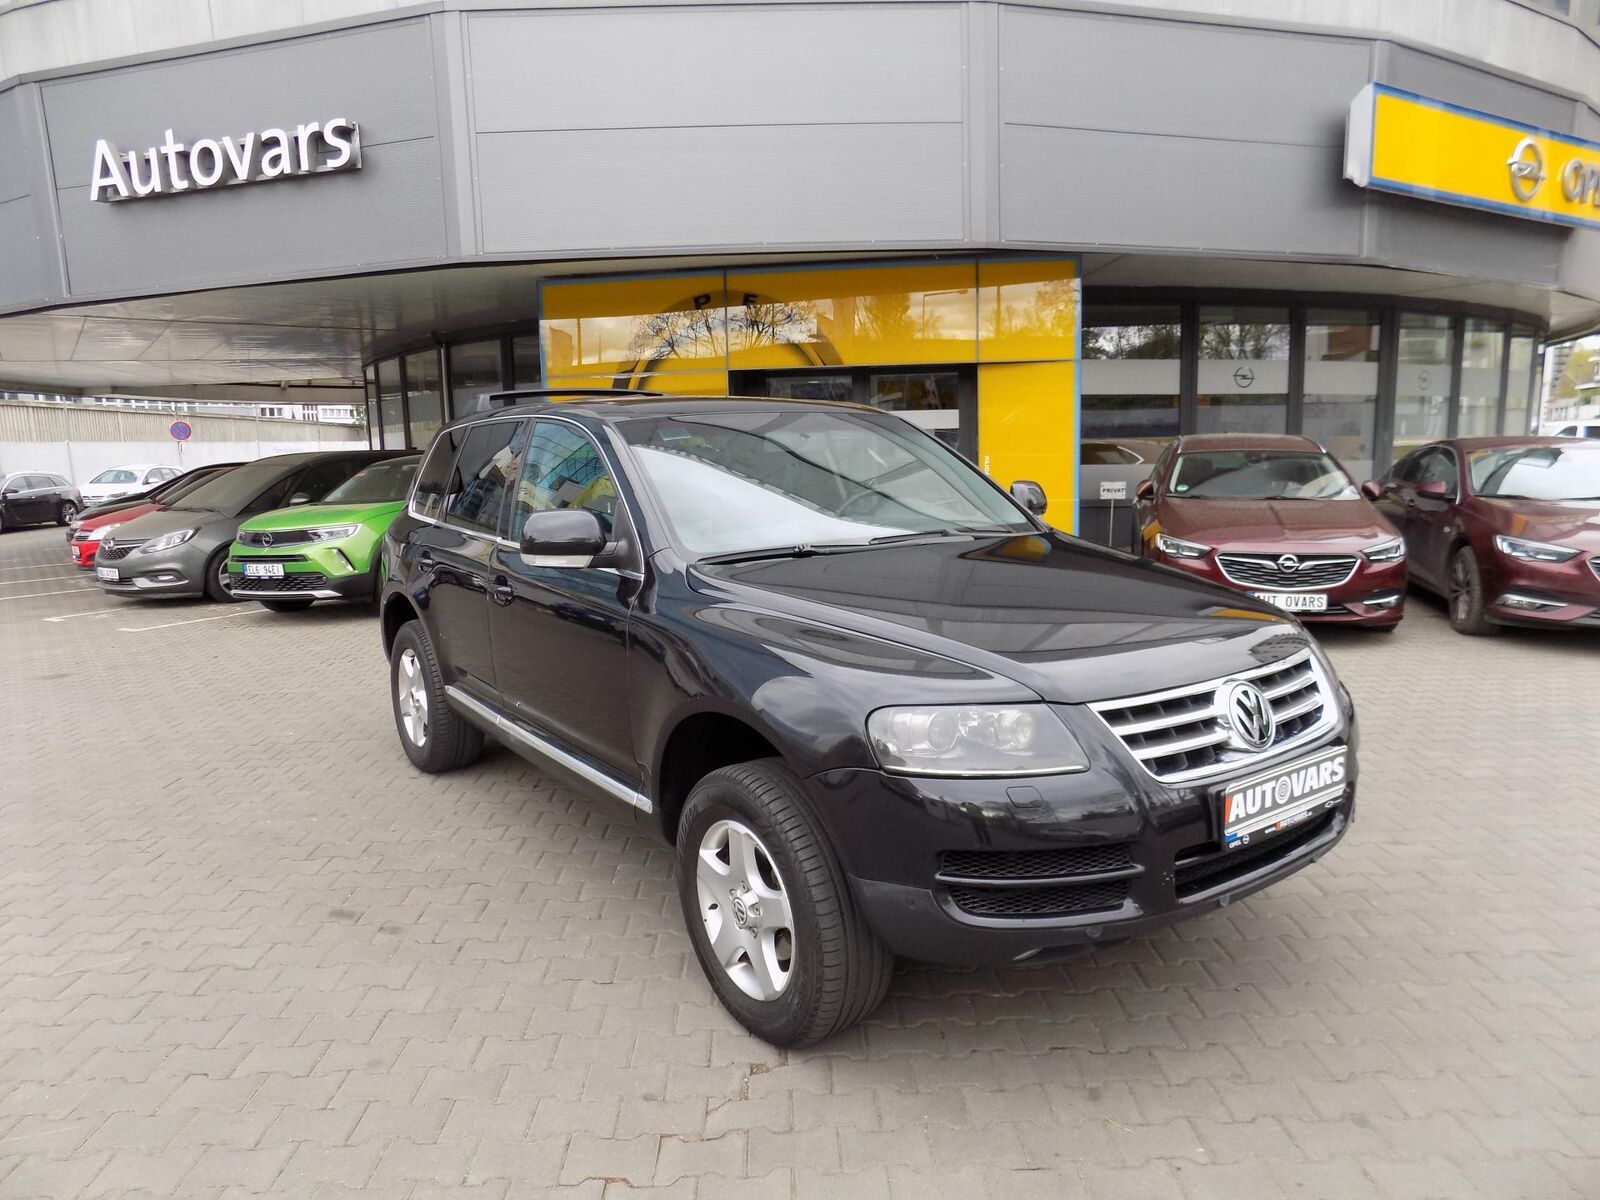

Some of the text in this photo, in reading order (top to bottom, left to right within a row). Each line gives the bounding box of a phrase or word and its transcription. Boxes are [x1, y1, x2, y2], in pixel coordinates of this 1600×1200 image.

[90, 117, 353, 200] Autovars
[1285, 596, 1324, 608] OVARS
[1228, 756, 1345, 823] AUTOVARS
